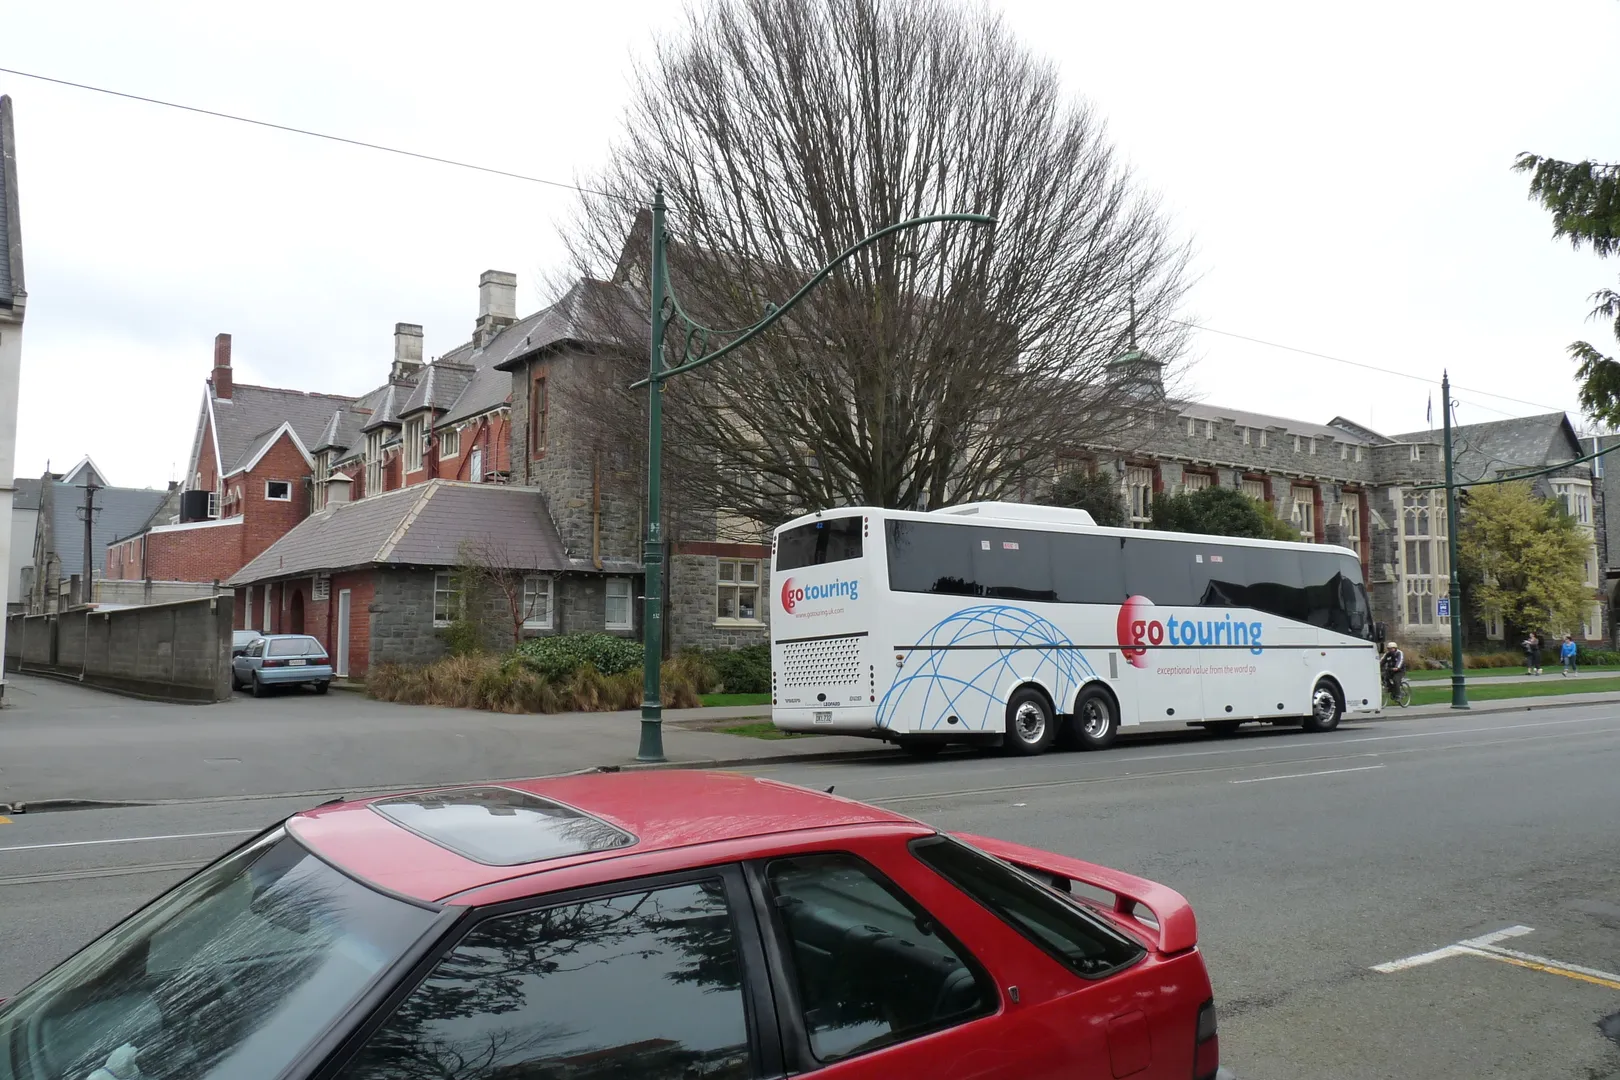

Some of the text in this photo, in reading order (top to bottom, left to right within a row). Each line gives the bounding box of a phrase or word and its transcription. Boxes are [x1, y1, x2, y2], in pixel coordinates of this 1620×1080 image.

[1166, 613, 1263, 655] touring
[1156, 664, 1256, 676] exceptional value from the word go
